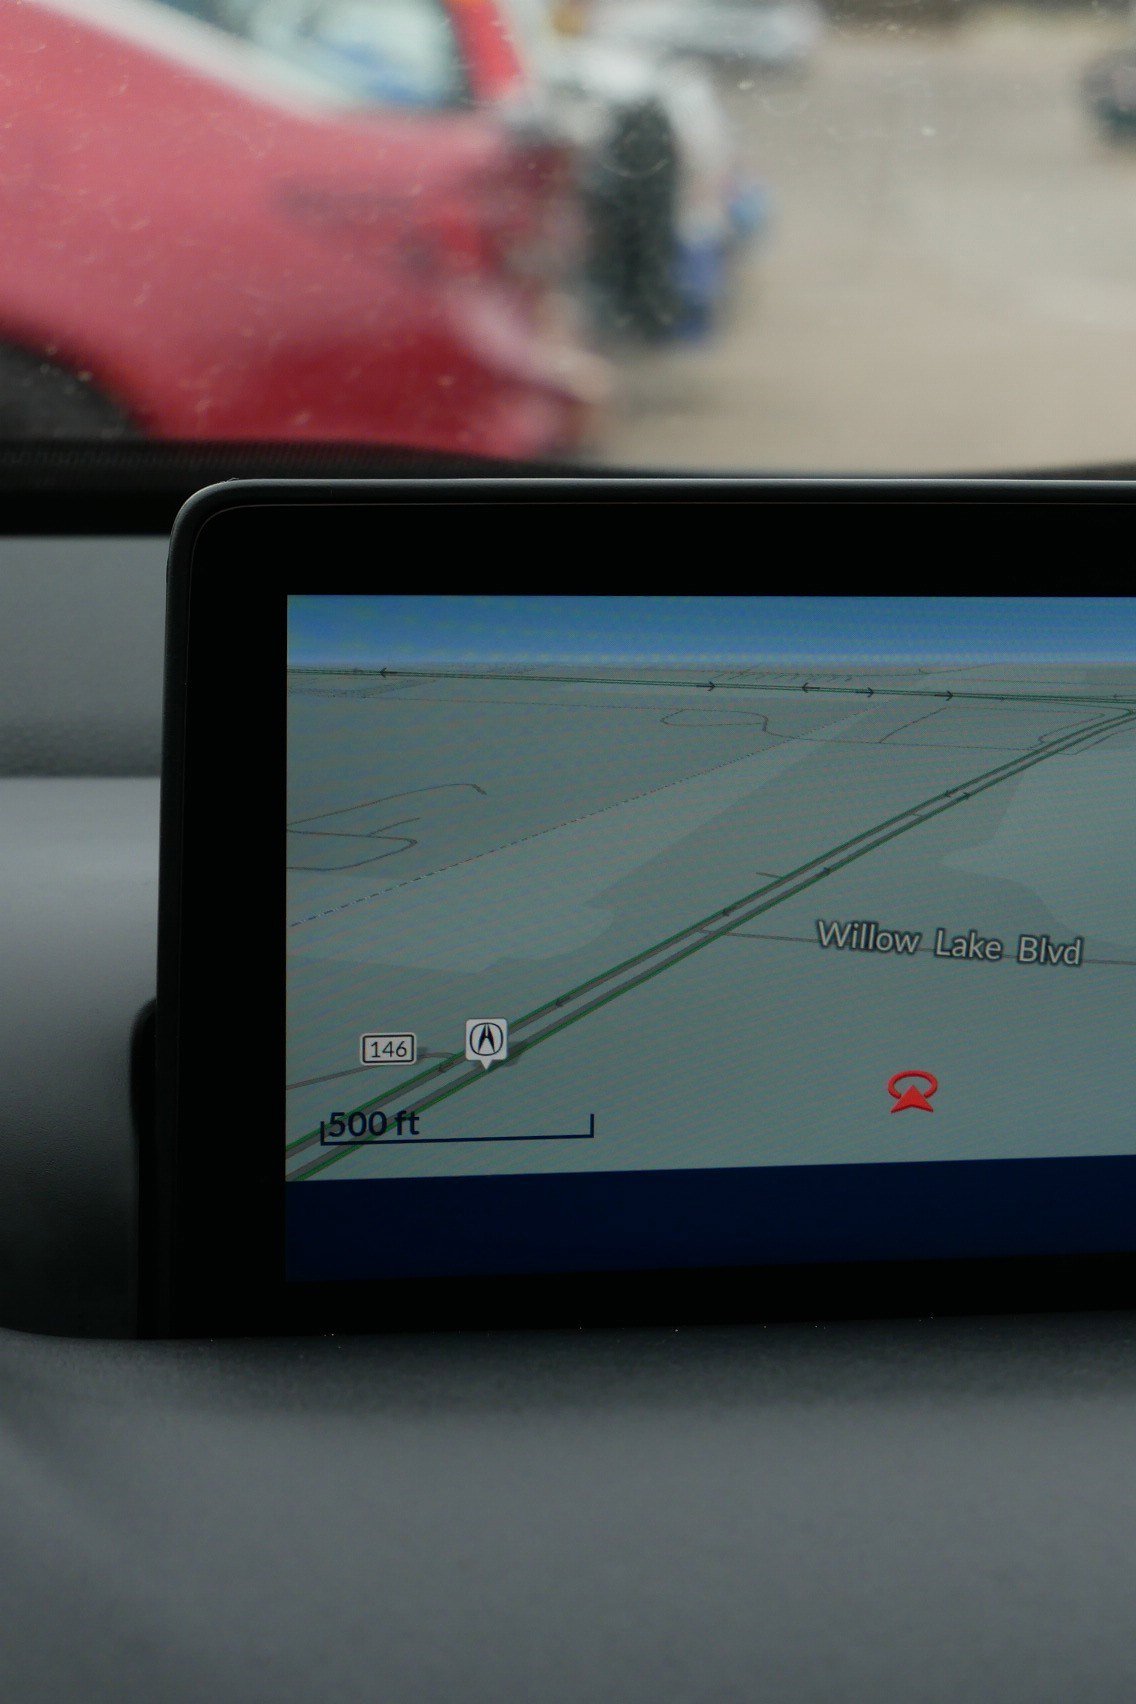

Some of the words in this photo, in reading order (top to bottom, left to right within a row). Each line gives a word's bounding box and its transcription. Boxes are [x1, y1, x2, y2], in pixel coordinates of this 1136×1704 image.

[816, 919, 920, 955] Willow
[935, 929, 1002, 960] Lake
[1017, 935, 1083, 966] Blvd
[370, 1041, 408, 1059] 146
[328, 1112, 387, 1137] 500
[394, 1111, 420, 1136] ft
